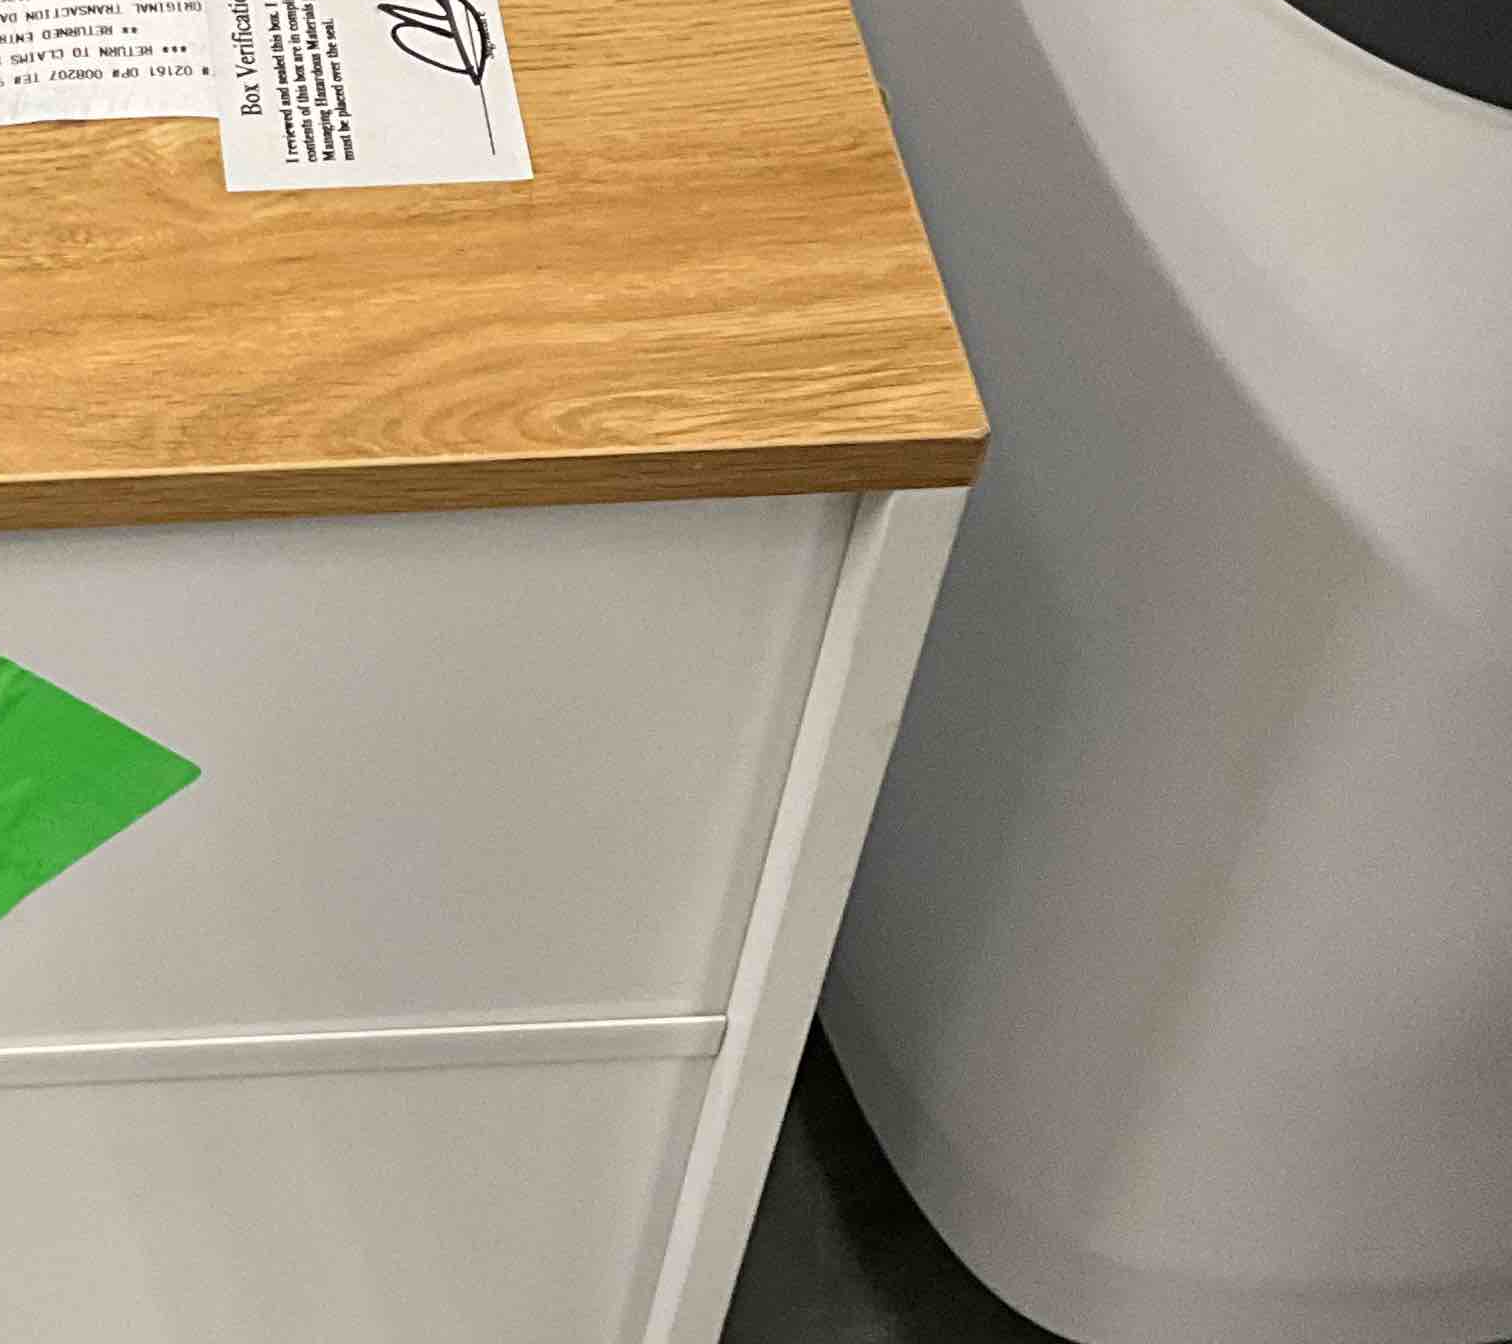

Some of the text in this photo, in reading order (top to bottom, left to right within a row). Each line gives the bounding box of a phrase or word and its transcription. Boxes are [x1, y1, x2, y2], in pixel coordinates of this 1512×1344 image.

[26, 4, 121, 21] TRANSACTION
[132, 2, 202, 14] ORIGINAL
[268, 11, 280, 31] box.
[300, 4, 319, 50] Materials
[42, 26, 112, 39] RETURNED
[288, 34, 300, 43] in
[99, 46, 152, 56] RETURN
[270, 35, 284, 52] this
[11, 49, 64, 64] CLAIMS
[73, 48, 88, 57] TO
[292, 47, 303, 62] are
[49, 69, 103, 80] 008207
[150, 66, 192, 76] 02161
[273, 56, 289, 84] sealed
[293, 65, 305, 81] box
[311, 54, 328, 106] Hazardous
[278, 87, 291, 106] and
[295, 85, 308, 102] this
[320, 18, 355, 161] must be placed over the seal.
[241, 83, 262, 115] Box
[298, 106, 309, 115] of
[280, 110, 298, 154] reviewed
[301, 119, 317, 162] contents
[318, 110, 335, 161] Managing
